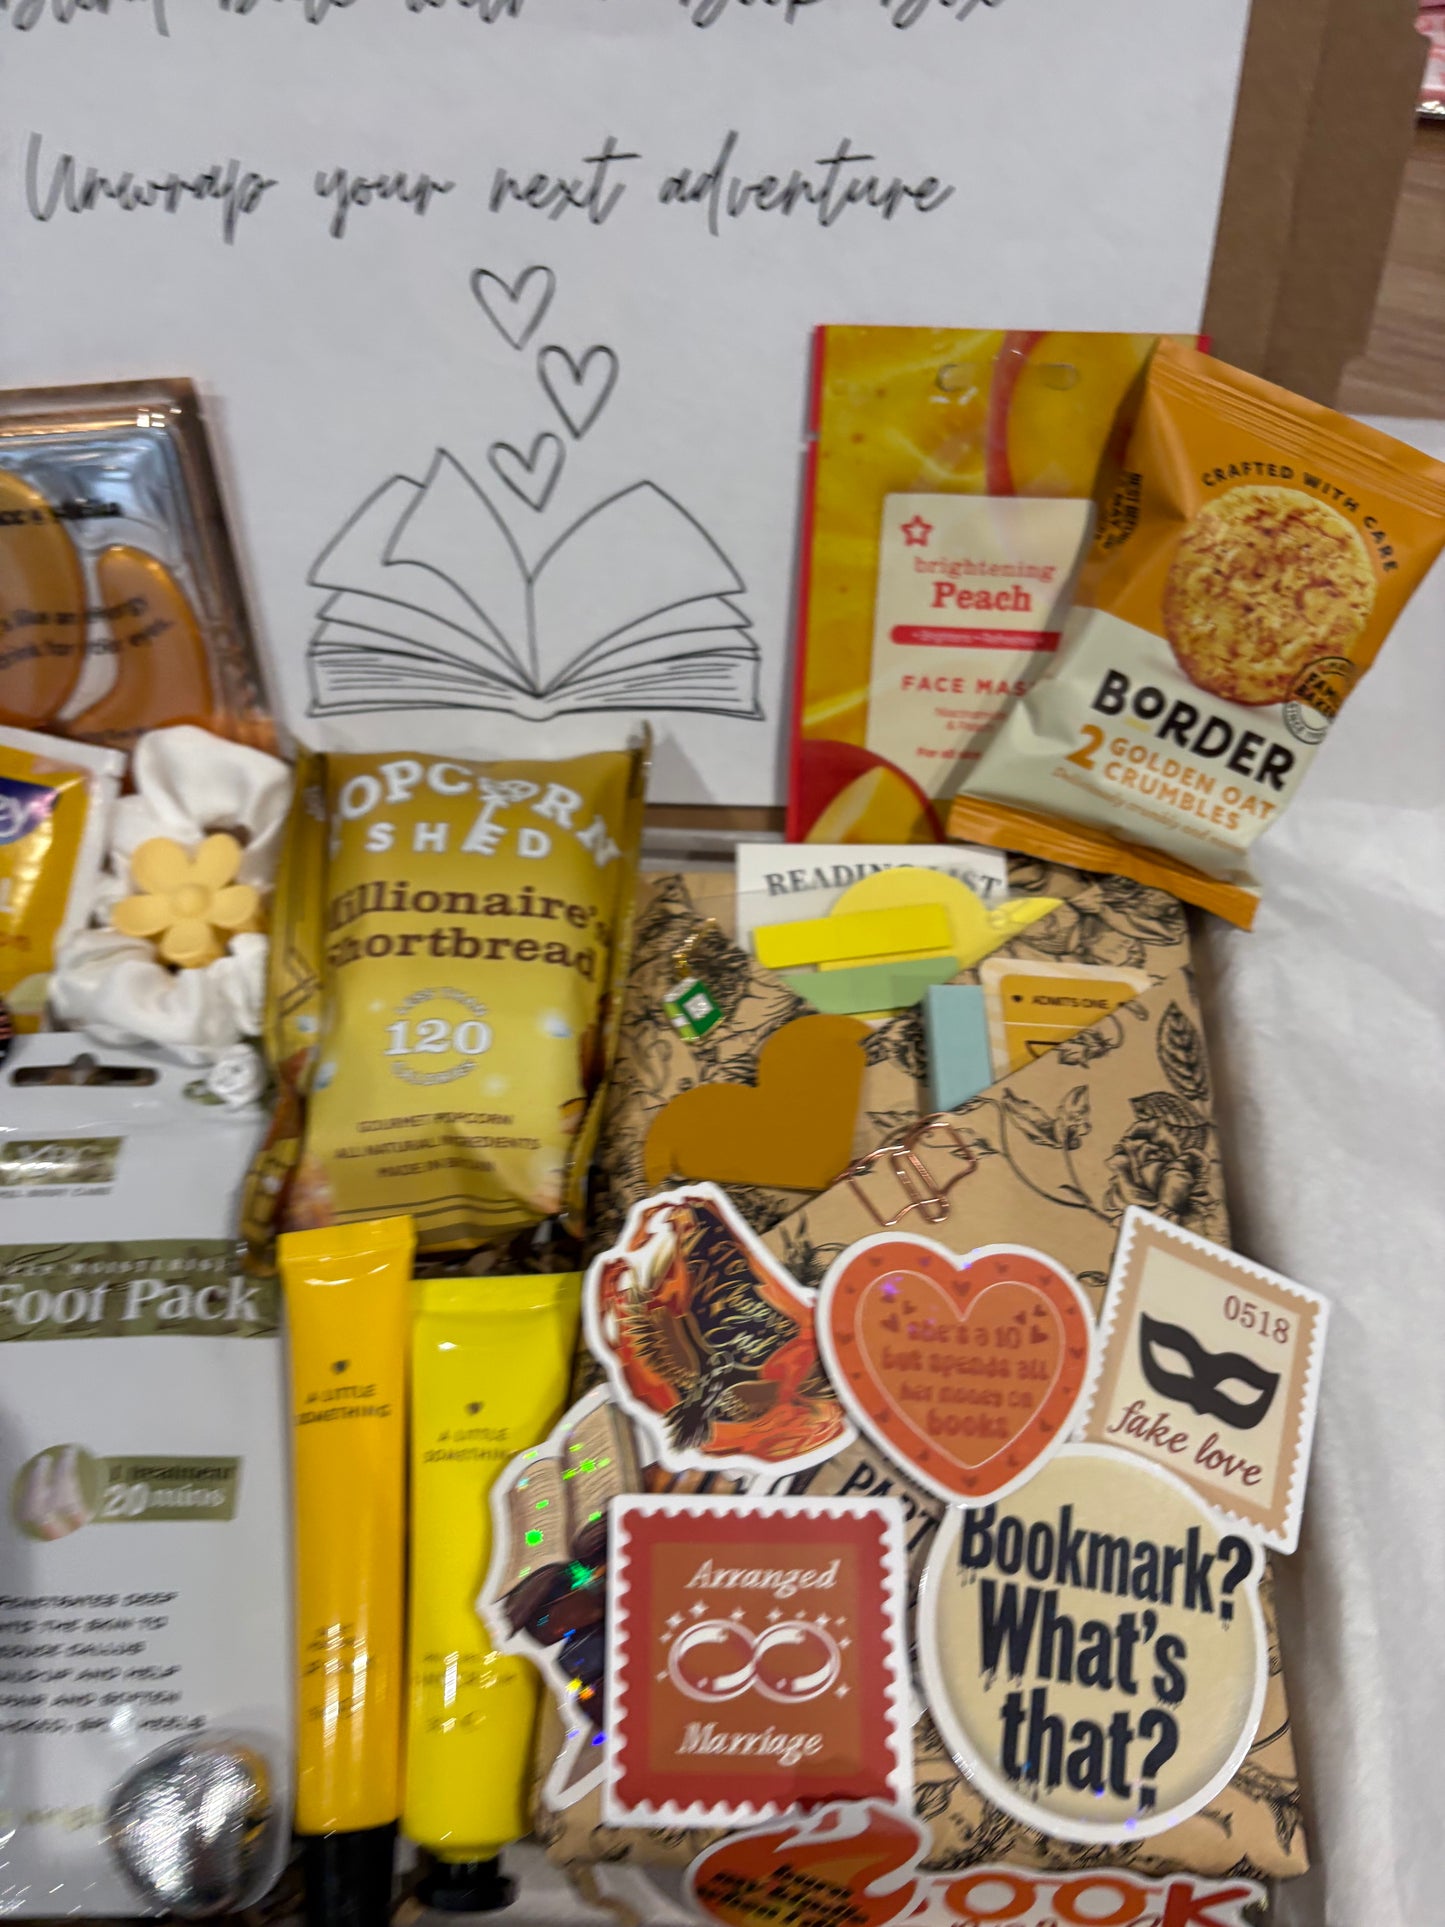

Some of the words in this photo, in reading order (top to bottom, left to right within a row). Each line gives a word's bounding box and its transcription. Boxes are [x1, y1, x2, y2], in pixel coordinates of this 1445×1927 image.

[26, 132, 278, 245] Unwrap
[314, 167, 455, 238] your
[489, 136, 642, 224] next
[659, 131, 956, 236] adventure
[1202, 460, 1294, 487] CRAFTED
[1303, 472, 1360, 511] WITH
[1364, 515, 1398, 572] CARE
[913, 556, 1056, 583] brightening
[931, 581, 1033, 612] Peach
[901, 675, 965, 694] FACE
[975, 679, 1034, 697] MAS
[1091, 669, 1295, 791] BORDER
[1065, 724, 1106, 771] 2
[1109, 737, 1216, 794] GOLDEN
[1221, 786, 1277, 820] OAT
[1103, 761, 1242, 830] CRUMBLES
[364, 821, 553, 860] SHED
[384, 1018, 492, 1056] 120
[121, 1275, 262, 1322] Pack
[1223, 1294, 1291, 1344] 0518
[1107, 1400, 1189, 1453] fake
[1193, 1432, 1263, 1487] love
[101, 1482, 150, 1517] 20
[684, 1557, 842, 1599] Arranged
[958, 1502, 1254, 1625] Bookmark?
[978, 1578, 1188, 1704] What's
[675, 1720, 824, 1767] Marriage
[1000, 1686, 1180, 1813] that?
